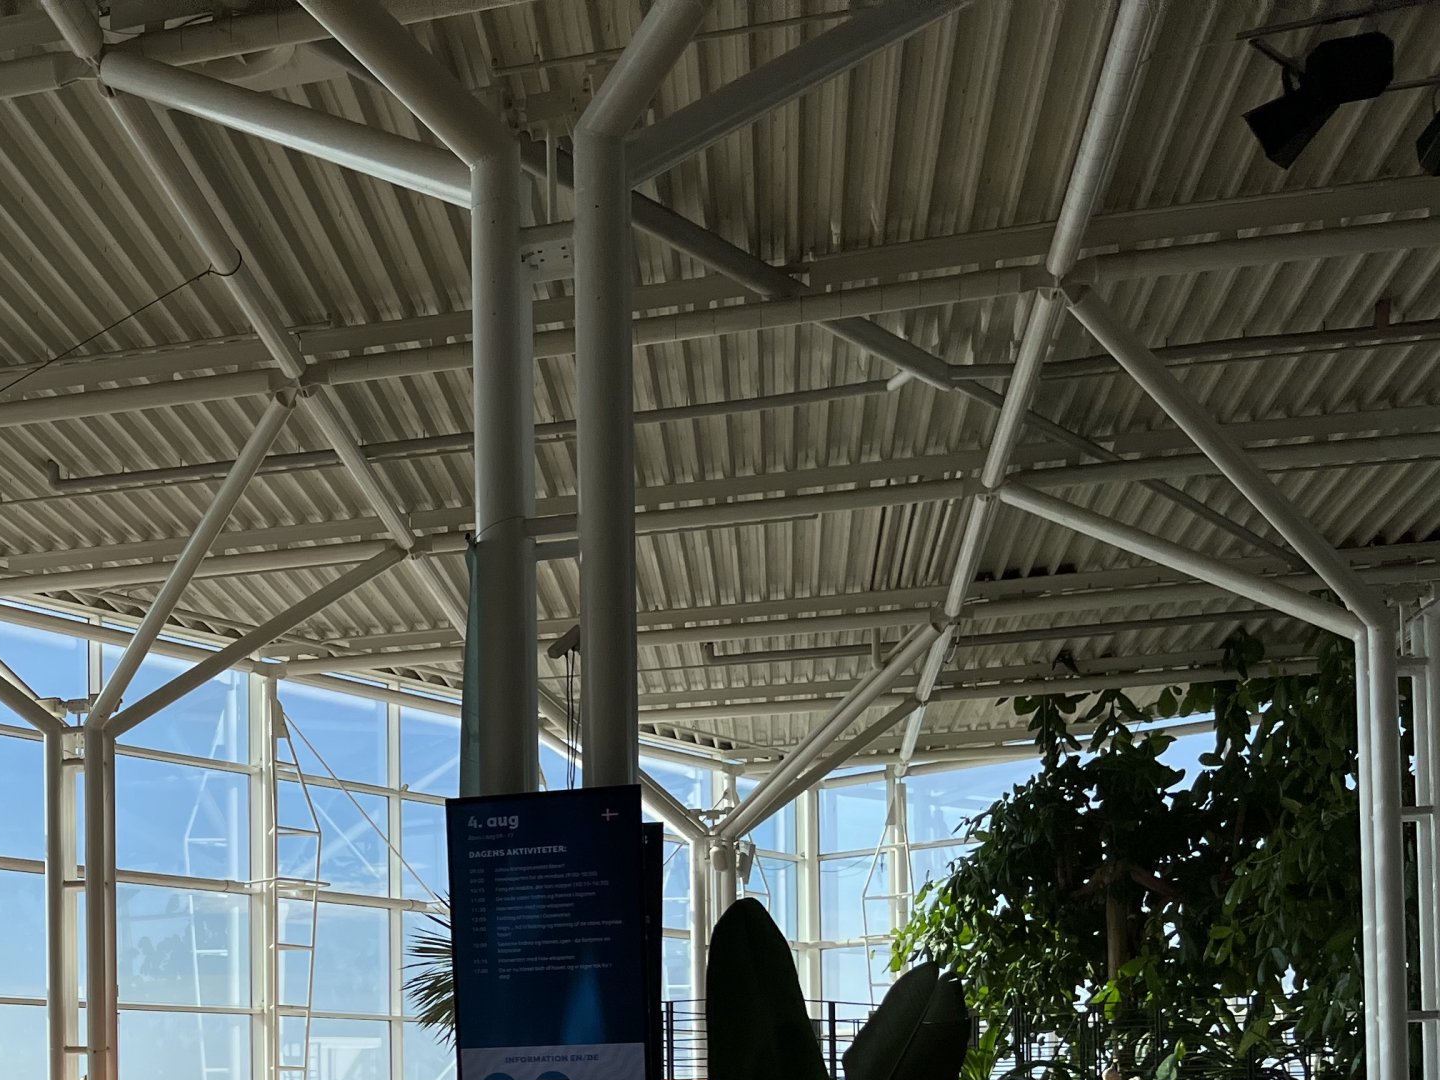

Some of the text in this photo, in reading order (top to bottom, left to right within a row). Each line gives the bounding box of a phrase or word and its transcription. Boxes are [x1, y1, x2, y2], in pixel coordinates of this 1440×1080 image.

[467, 815, 519, 829] 4. aug
[468, 849, 505, 858] DAGENS
[505, 1055, 568, 1064] INFORMATION
